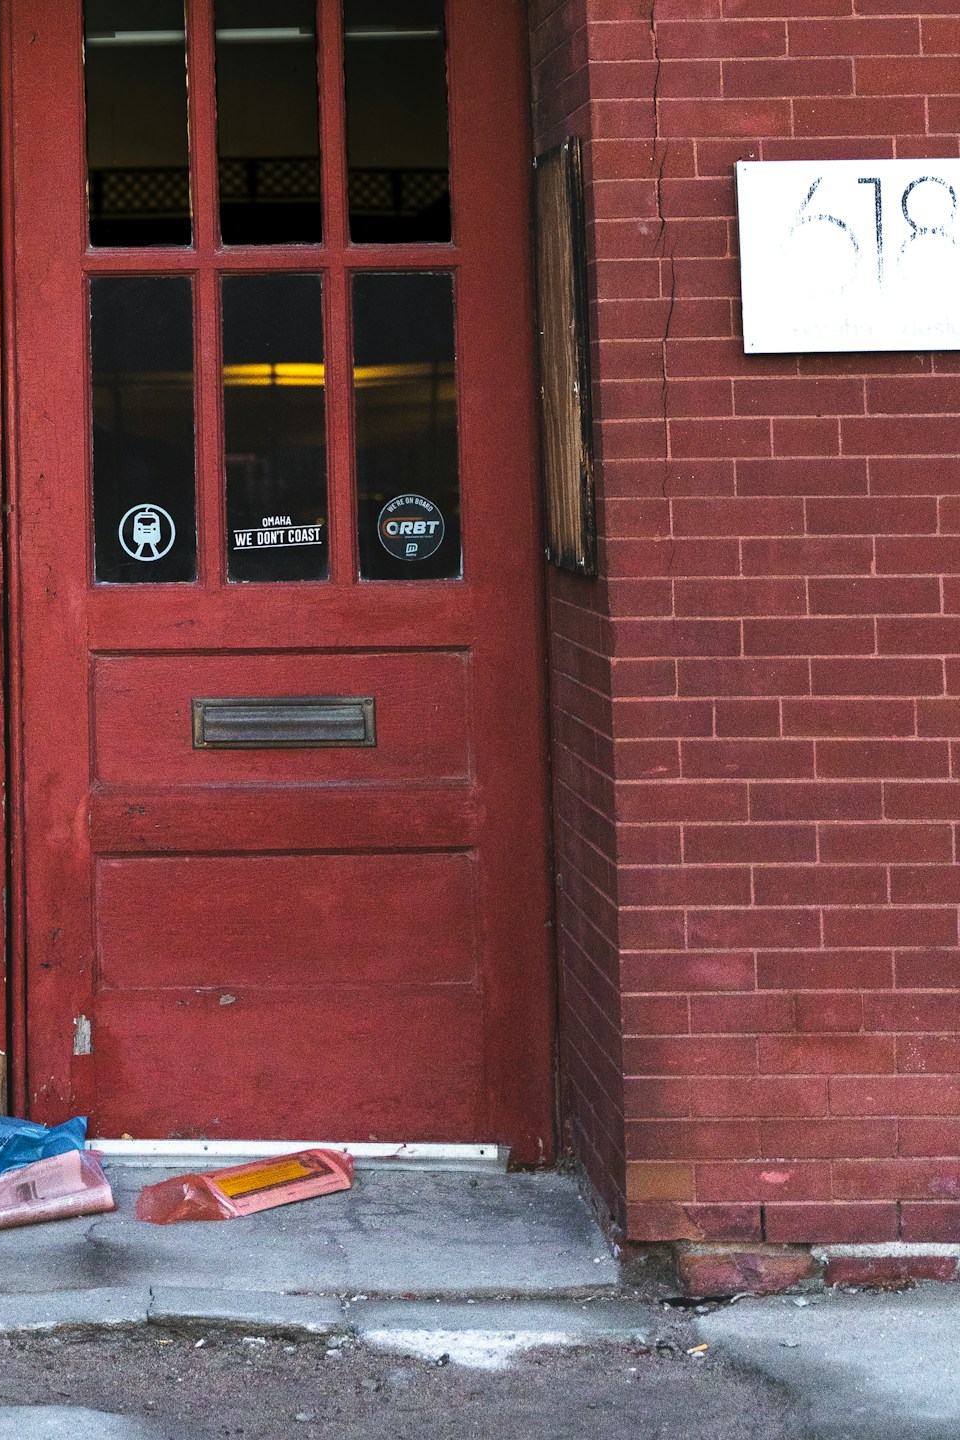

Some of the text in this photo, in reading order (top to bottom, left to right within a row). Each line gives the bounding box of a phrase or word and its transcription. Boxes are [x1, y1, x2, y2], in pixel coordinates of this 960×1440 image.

[780, 175, 960, 296] 618
[386, 497, 434, 513] WE'RE ON BOARD
[262, 516, 292, 527] OMAHA
[386, 521, 440, 535] ORBT
[234, 527, 321, 546] WE DON'T COAST
